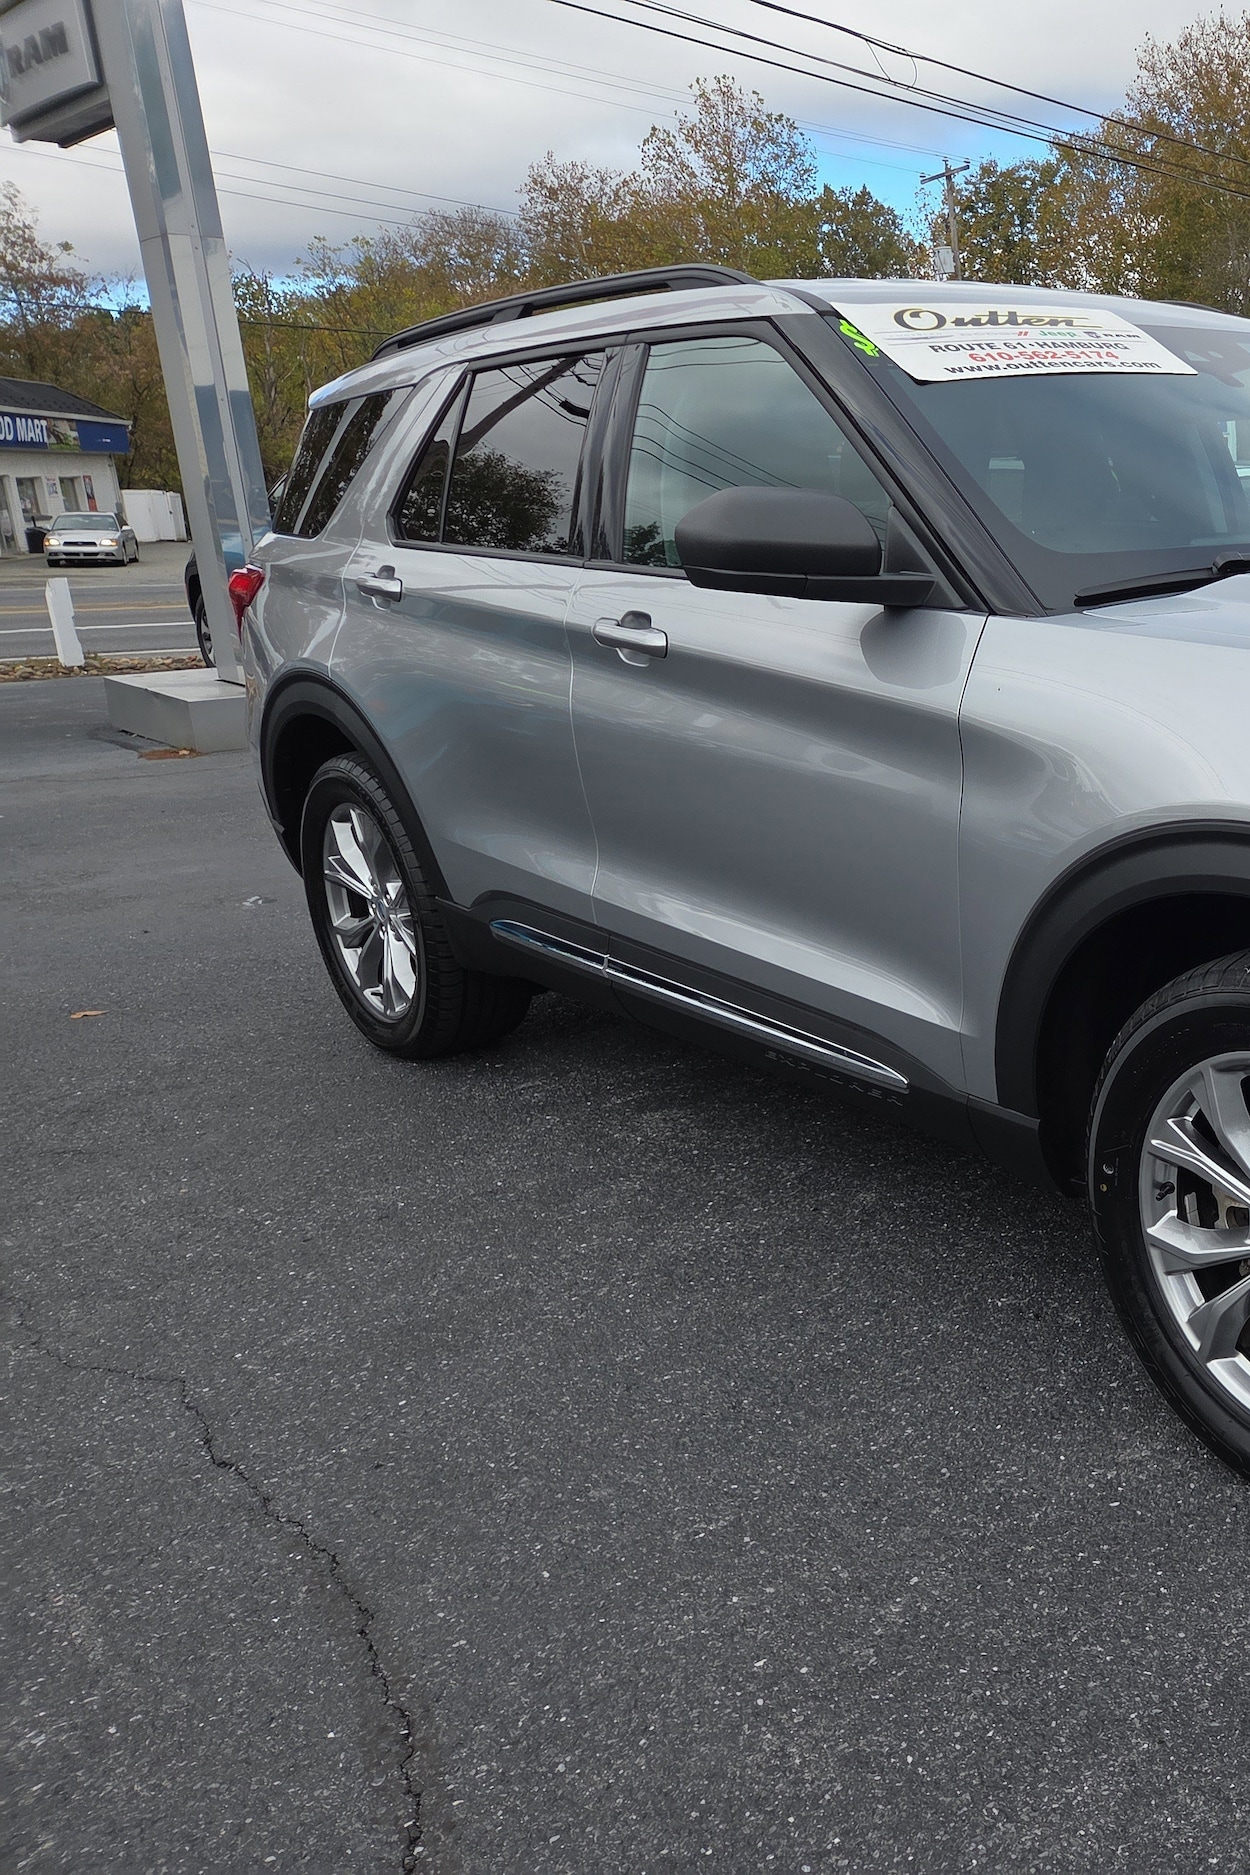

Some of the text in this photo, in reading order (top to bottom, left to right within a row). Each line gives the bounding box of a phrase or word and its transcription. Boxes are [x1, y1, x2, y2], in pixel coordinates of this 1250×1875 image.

[6, 20, 70, 79] RAM
[893, 308, 1098, 331] Outten
[929, 342, 1006, 353] ROUTE
[968, 350, 1119, 363] 610-562-5174
[944, 359, 1162, 375] www.outtencars.com
[16, 417, 48, 443] MART
